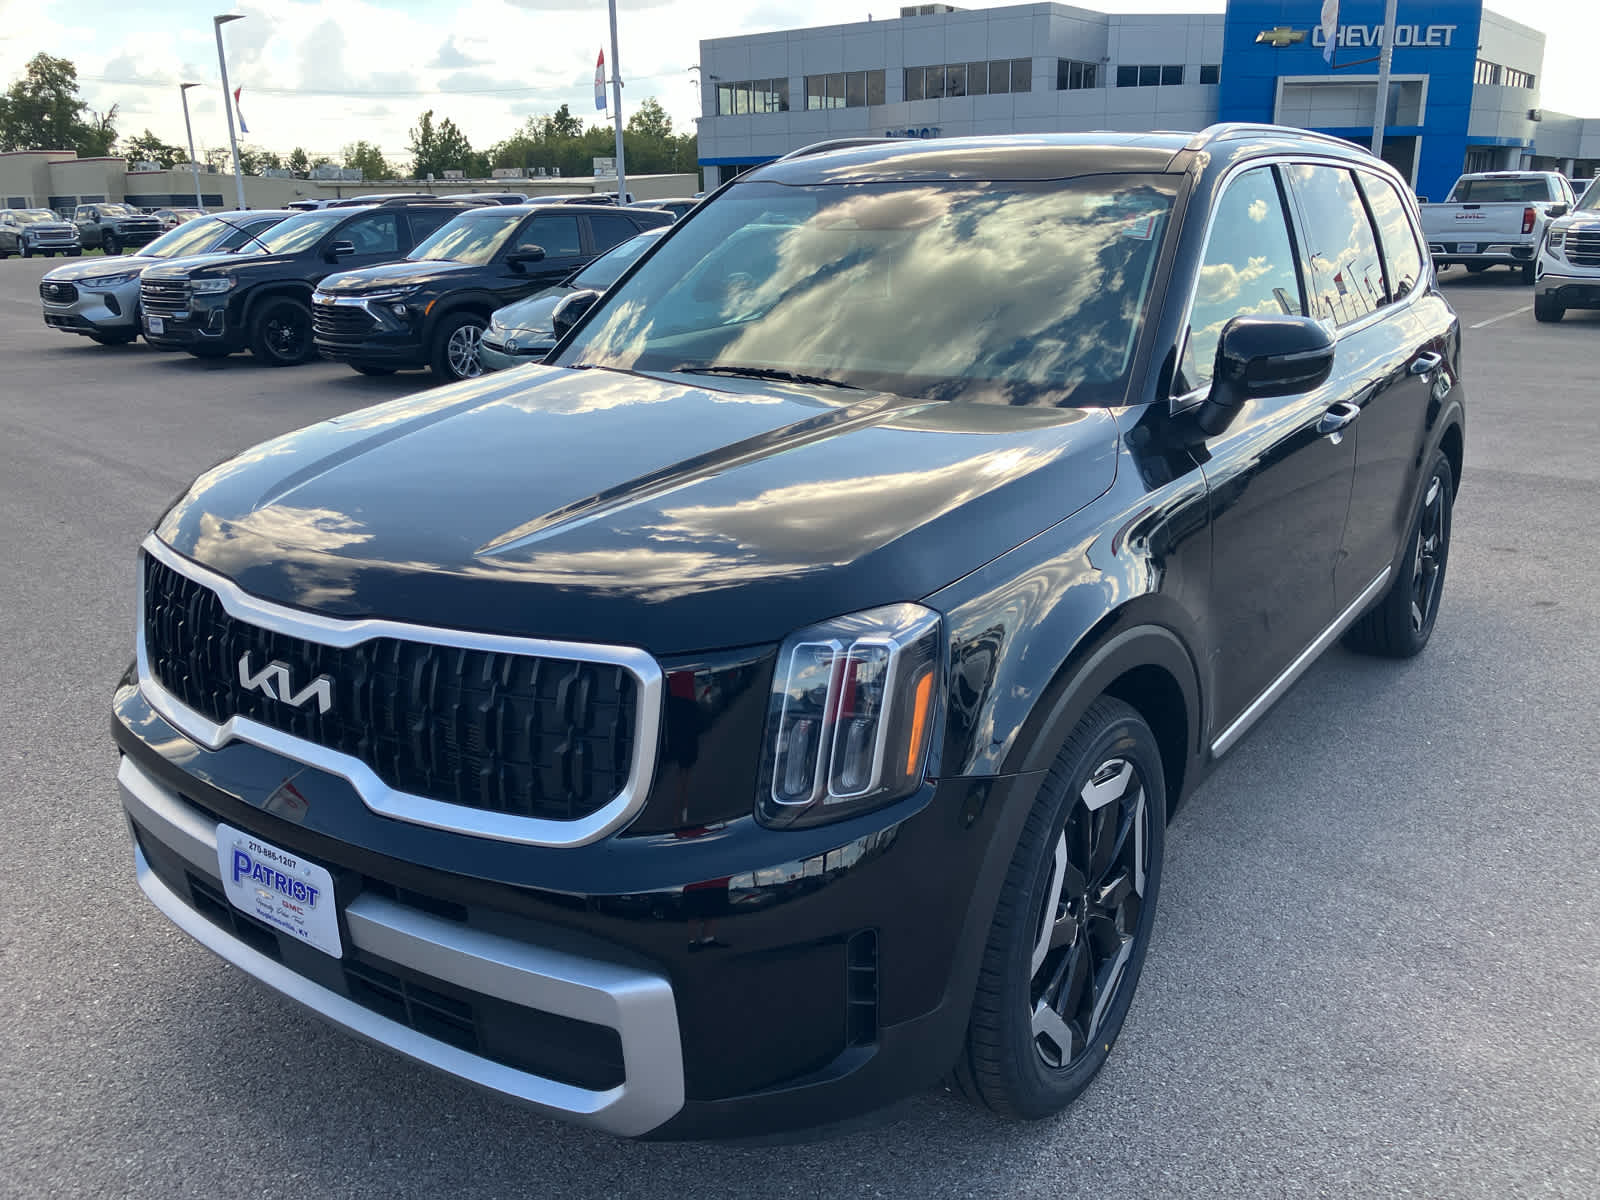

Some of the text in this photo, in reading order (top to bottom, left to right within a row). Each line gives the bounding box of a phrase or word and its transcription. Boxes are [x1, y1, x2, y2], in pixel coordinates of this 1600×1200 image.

[238, 650, 332, 714] KIA
[233, 848, 319, 907] PATRIOT
[281, 899, 305, 916] GMC
